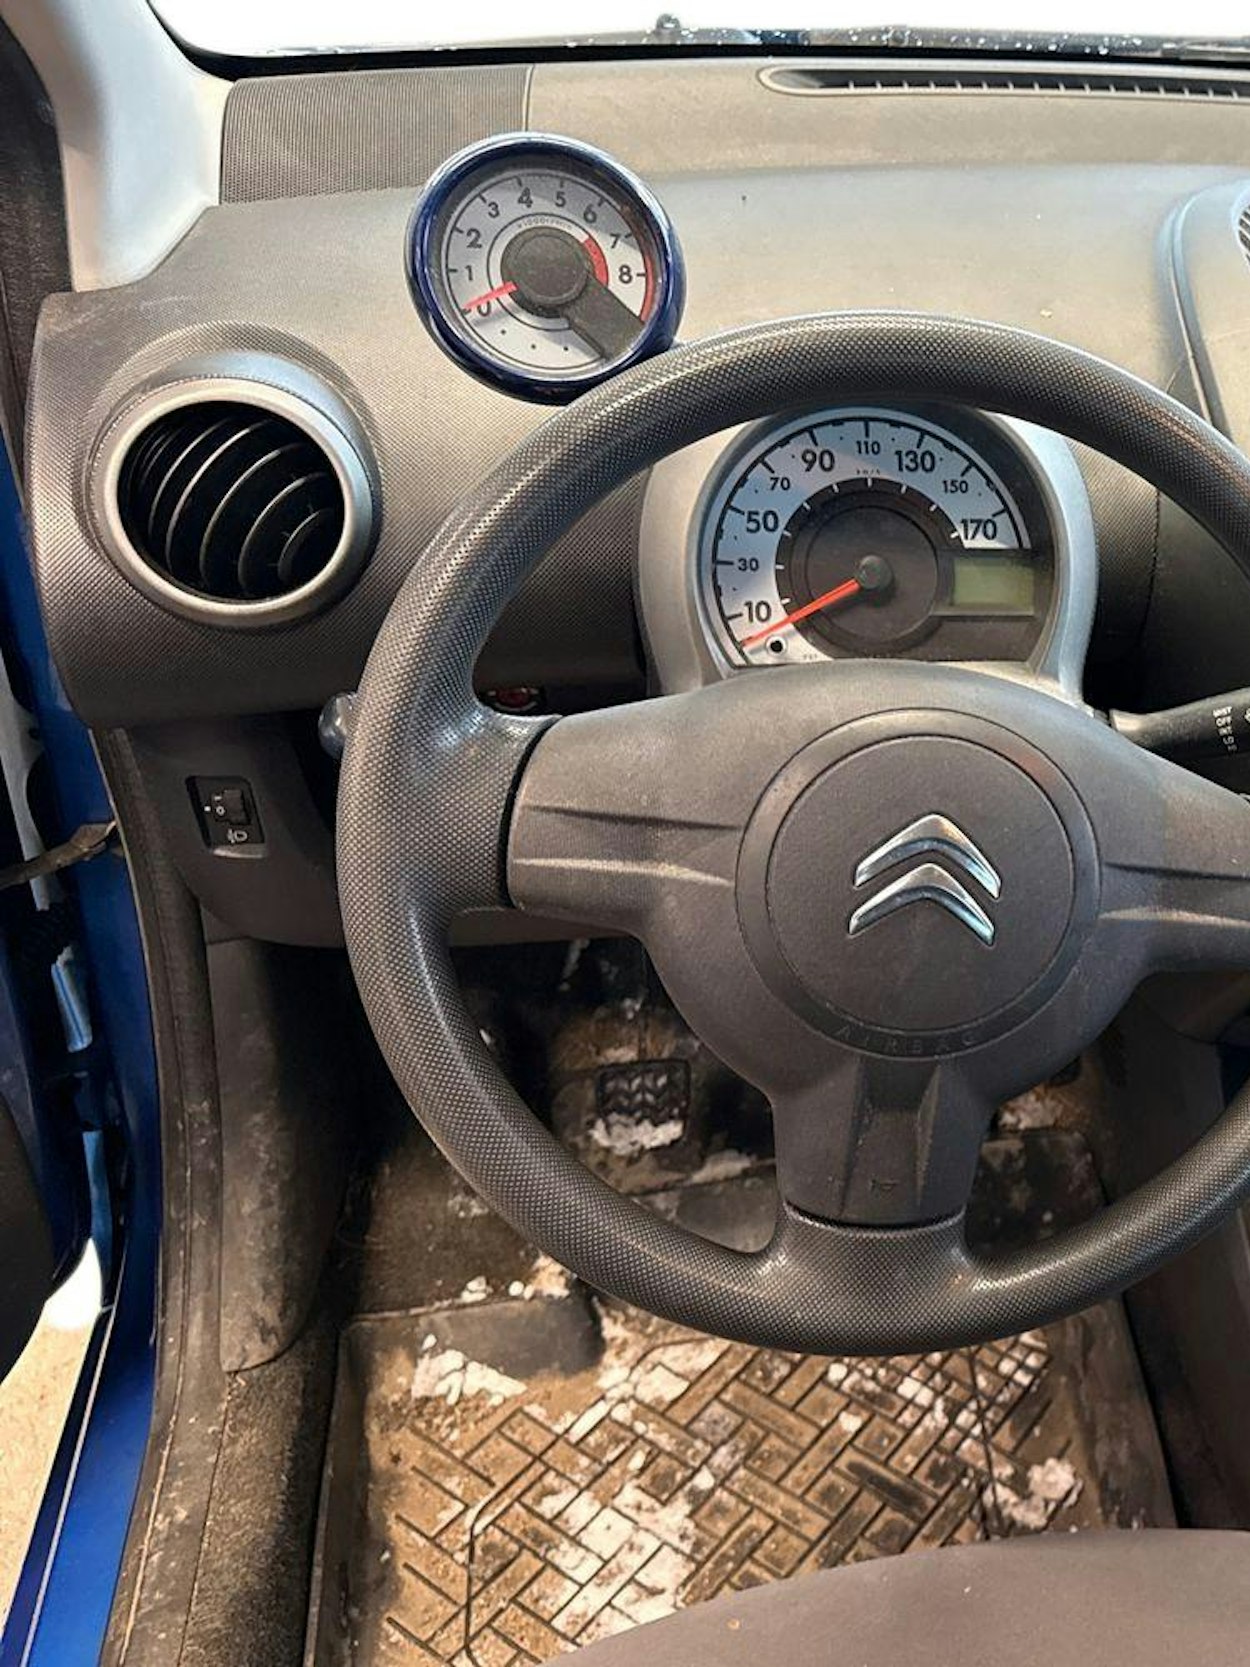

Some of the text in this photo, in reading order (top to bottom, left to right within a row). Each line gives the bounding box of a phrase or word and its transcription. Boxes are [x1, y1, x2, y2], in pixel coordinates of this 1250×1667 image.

[518, 187, 533, 208] 4
[555, 191, 567, 208] 5
[487, 201, 500, 219] 3
[583, 202, 598, 224] 6
[465, 228, 483, 249] 2
[609, 233, 622, 249] 7
[464, 264, 474, 281] 1
[618, 264, 633, 284] 8
[476, 302, 491, 317] 0
[856, 440, 880, 455] 110
[801, 448, 835, 473] 90
[894, 449, 936, 473] 130
[769, 477, 791, 491] 70
[942, 479, 969, 494] 150
[745, 510, 779, 533] 50
[960, 518, 998, 541] 170
[738, 558, 759, 572] 30
[743, 600, 772, 623] 10
